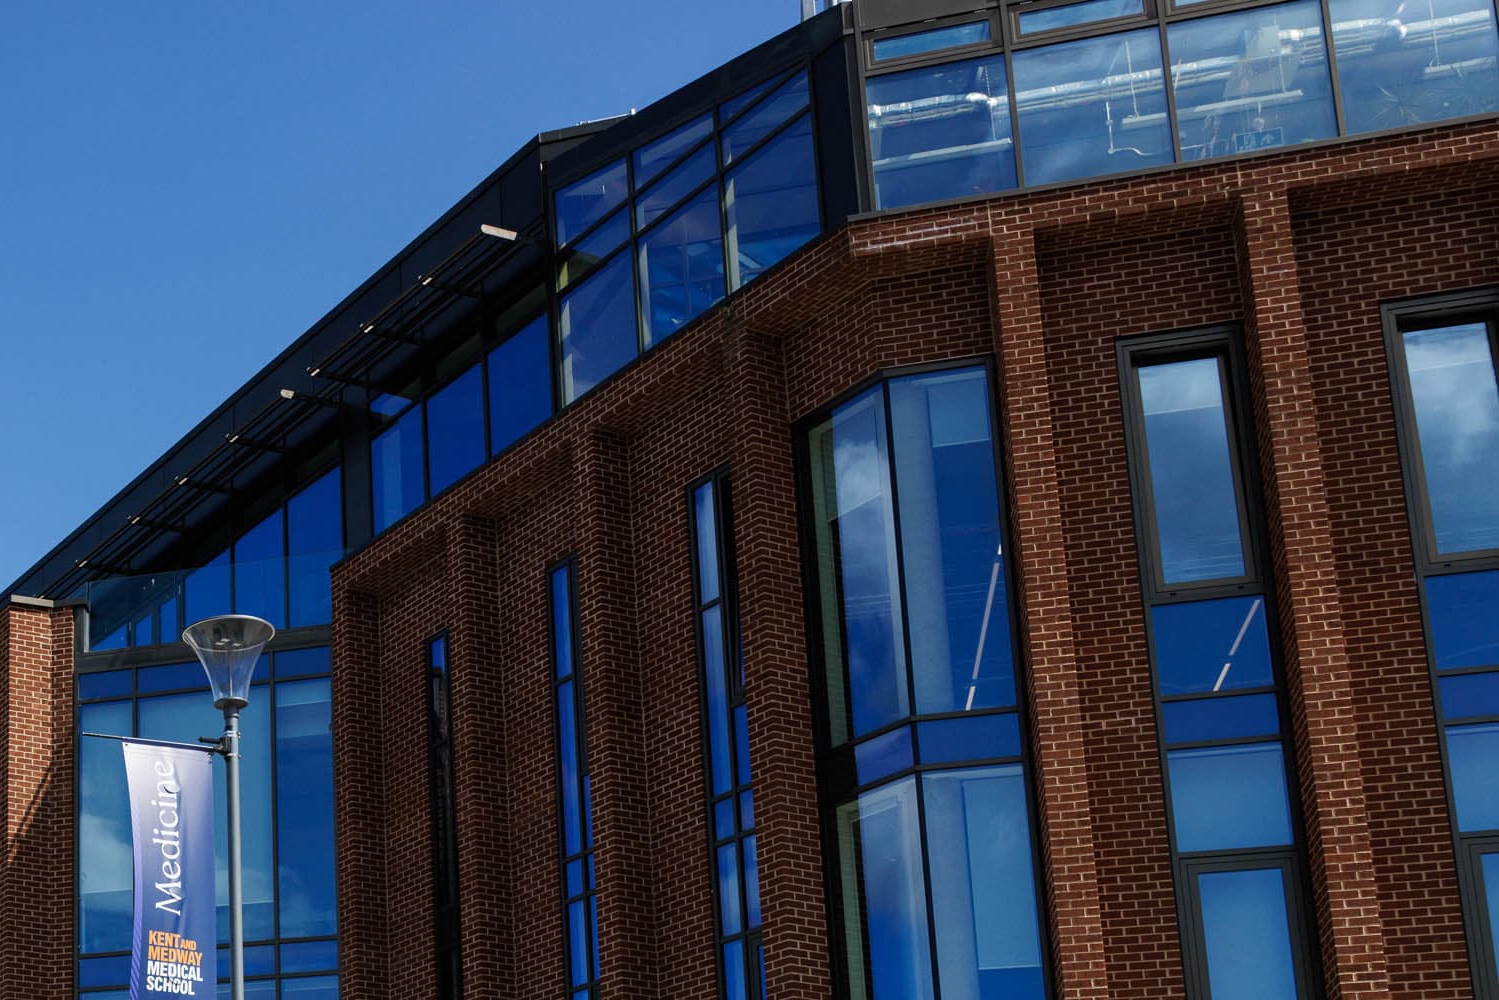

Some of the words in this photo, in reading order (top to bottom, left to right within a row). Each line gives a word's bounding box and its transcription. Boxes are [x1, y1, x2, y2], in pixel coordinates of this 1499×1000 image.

[152, 758, 182, 916] Medicine
[148, 930, 181, 948] KENT
[180, 939, 197, 951] AND
[148, 945, 203, 967] MEDWAY
[147, 960, 203, 982] MEDICAL
[146, 975, 196, 996] SCHOOL
